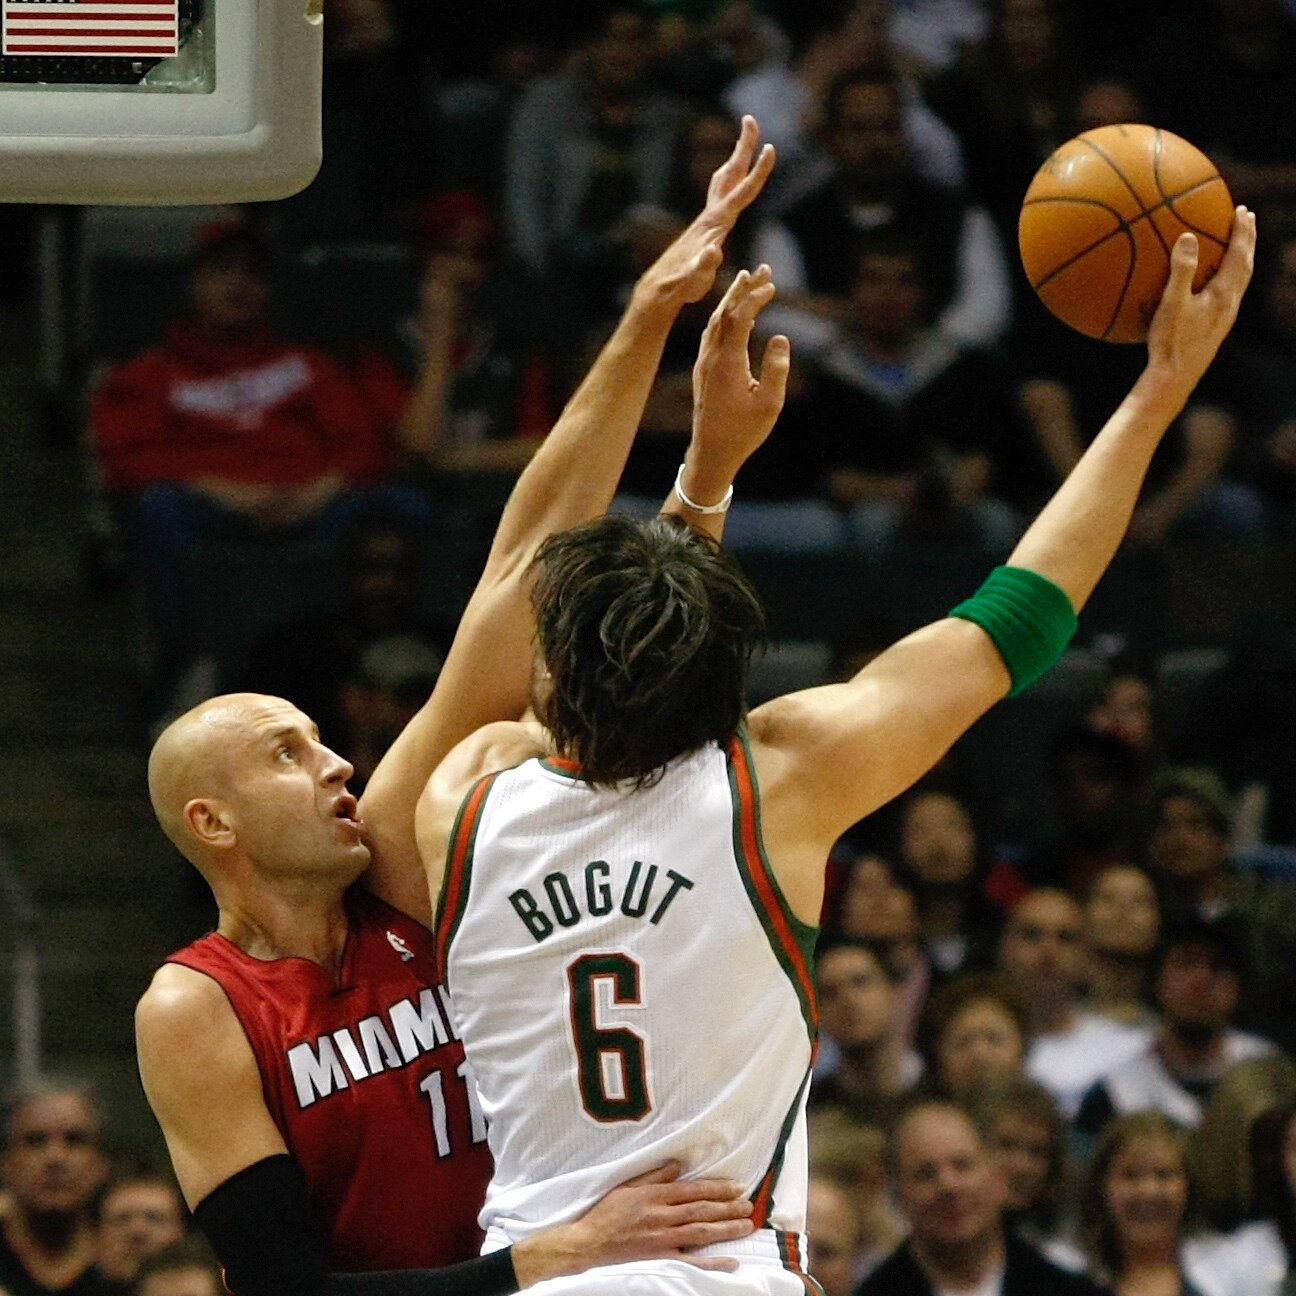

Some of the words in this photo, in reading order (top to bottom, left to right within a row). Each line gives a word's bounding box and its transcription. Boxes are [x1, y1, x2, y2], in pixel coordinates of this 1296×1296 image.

[507, 859, 695, 943] BOGUT
[566, 952, 653, 1123] 6
[419, 1059, 488, 1158] 11
